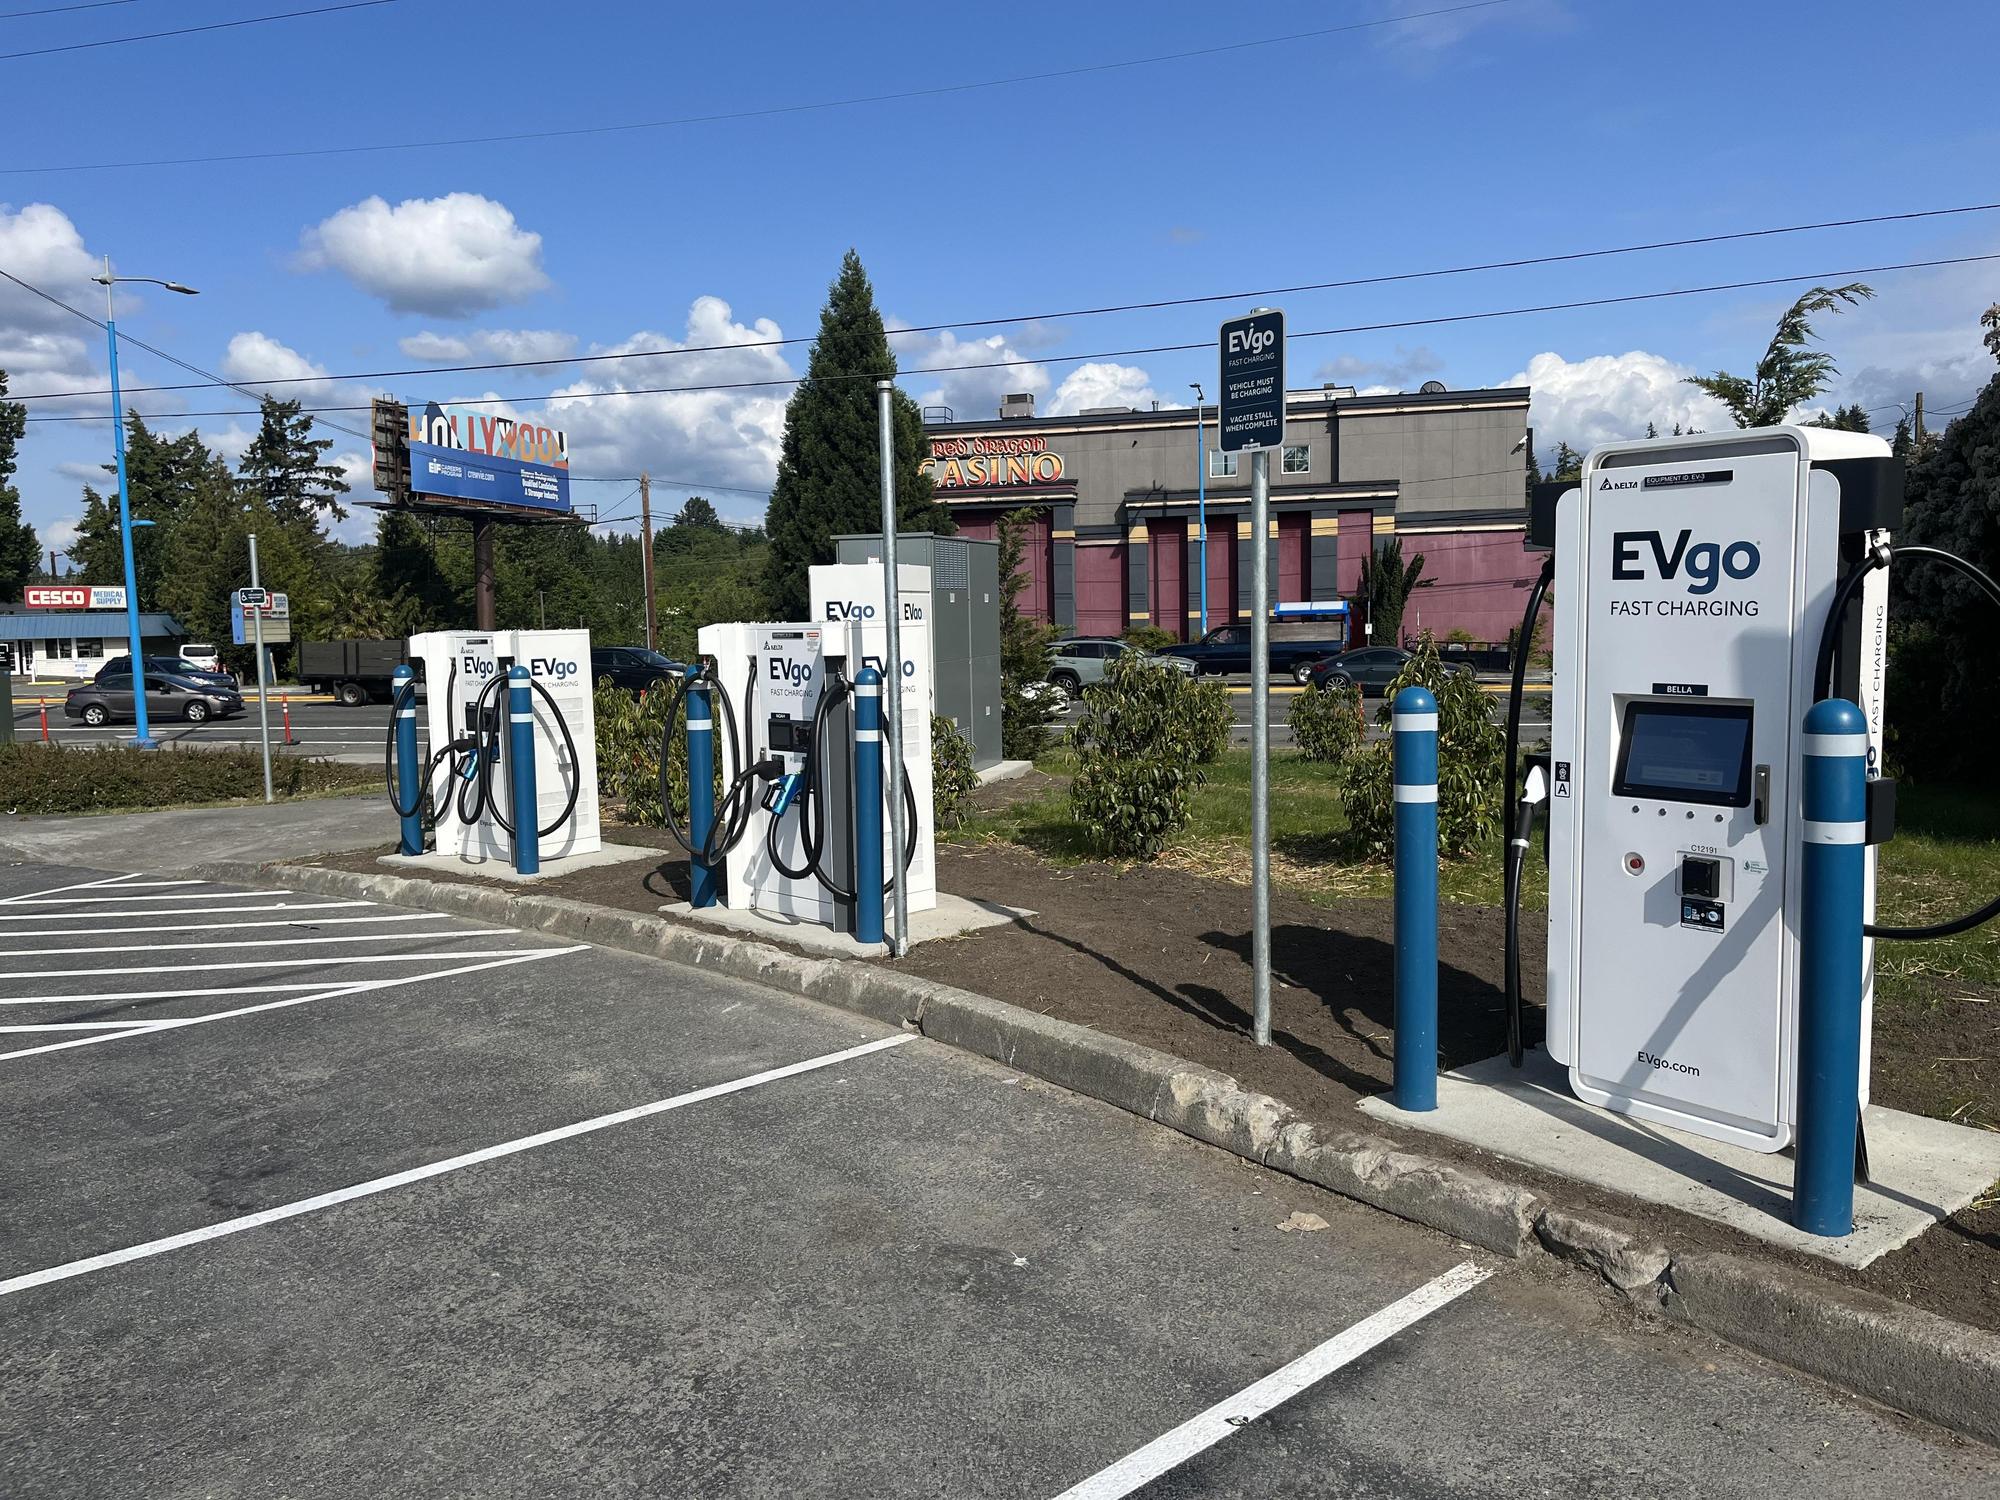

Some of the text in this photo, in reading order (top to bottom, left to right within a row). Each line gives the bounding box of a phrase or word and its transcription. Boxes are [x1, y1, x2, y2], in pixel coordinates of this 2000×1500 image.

[1229, 327, 1275, 354] EVgo
[1229, 352, 1275, 367] FAST CHARGING
[1229, 377, 1275, 391] VEHICLE MUST
[1239, 386, 1273, 398] CHARGING
[1230, 411, 1273, 424] VACATE STALL
[1225, 419, 1278, 433] WHEN COMPLETE
[918, 451, 1065, 488] CASINO
[1614, 481, 1638, 490] DELTA
[1646, 475, 1681, 484] EQUIPMENT
[1612, 529, 1761, 595] EVgo
[28, 590, 85, 605] CESCO
[826, 600, 875, 621] EVgo
[1610, 600, 1759, 617] FAST CHARGING
[464, 656, 494, 679] EVgo
[531, 657, 578, 680] EVgo
[769, 657, 812, 687] EVgo
[1871, 605, 1885, 734] FAST CHARGING
[770, 688, 783, 696] FAST
[1666, 685, 1693, 694] BELLA
[1557, 783, 1568, 795] A
[1691, 844, 1718, 854] C12191
[1637, 1050, 1700, 1077] EVgo.com
